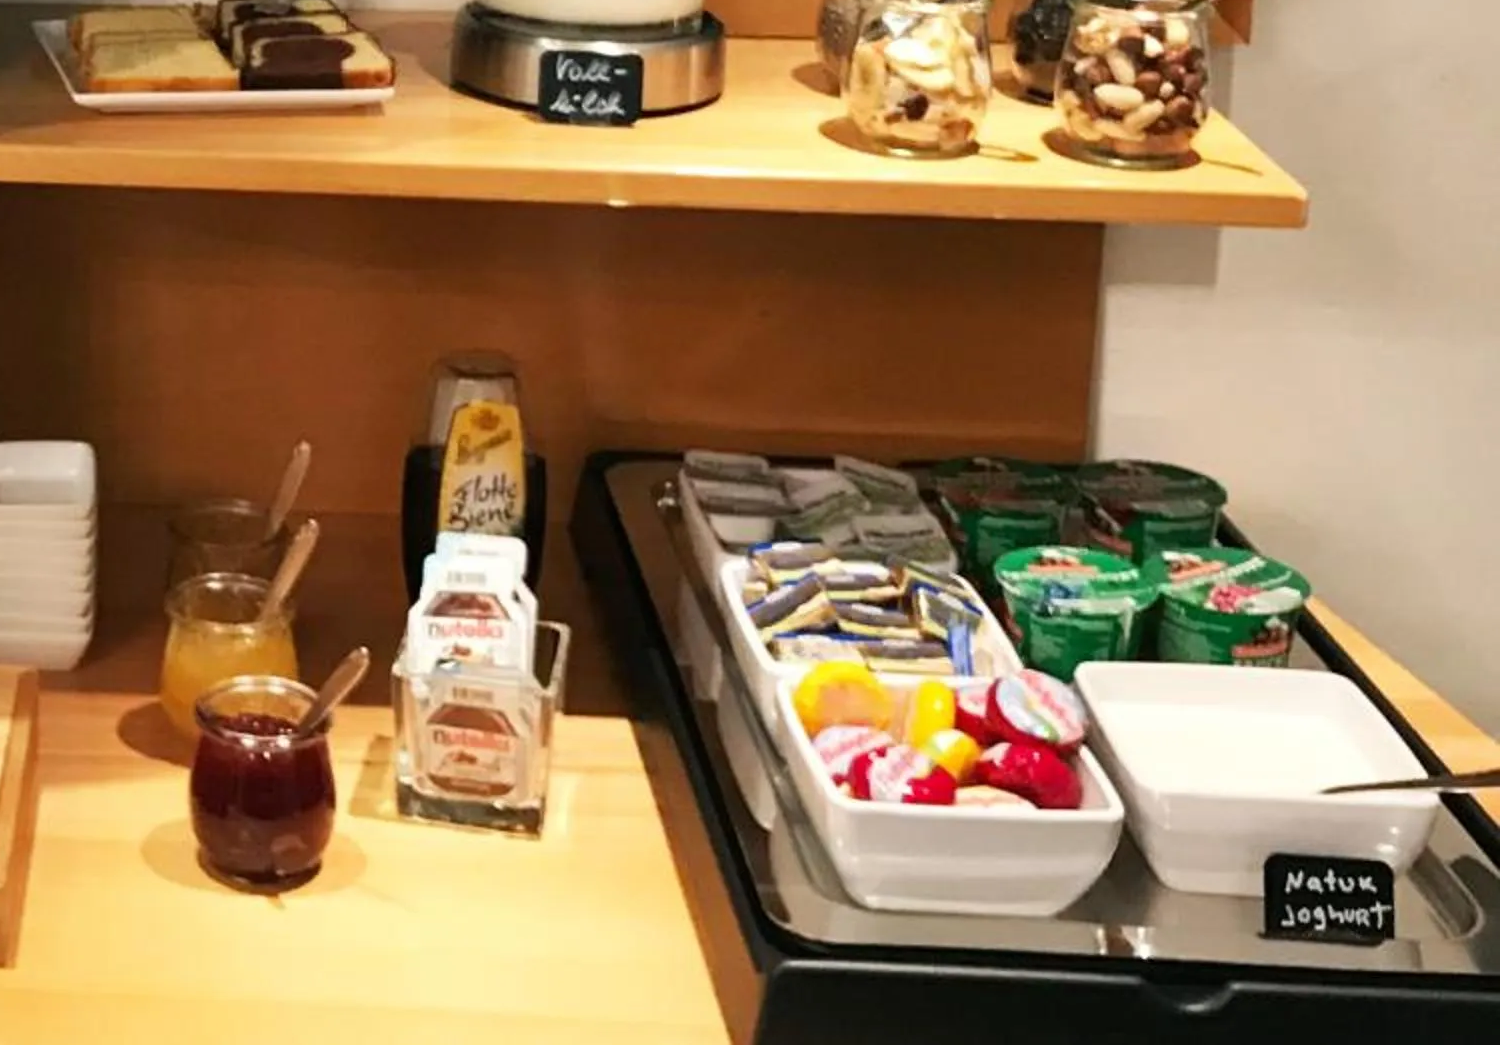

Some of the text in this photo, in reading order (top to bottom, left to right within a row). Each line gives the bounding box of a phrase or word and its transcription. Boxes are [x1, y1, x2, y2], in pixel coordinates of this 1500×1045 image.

[452, 472, 518, 504] Flotte
[447, 501, 516, 532] Biene
[1284, 868, 1378, 894] Natur
